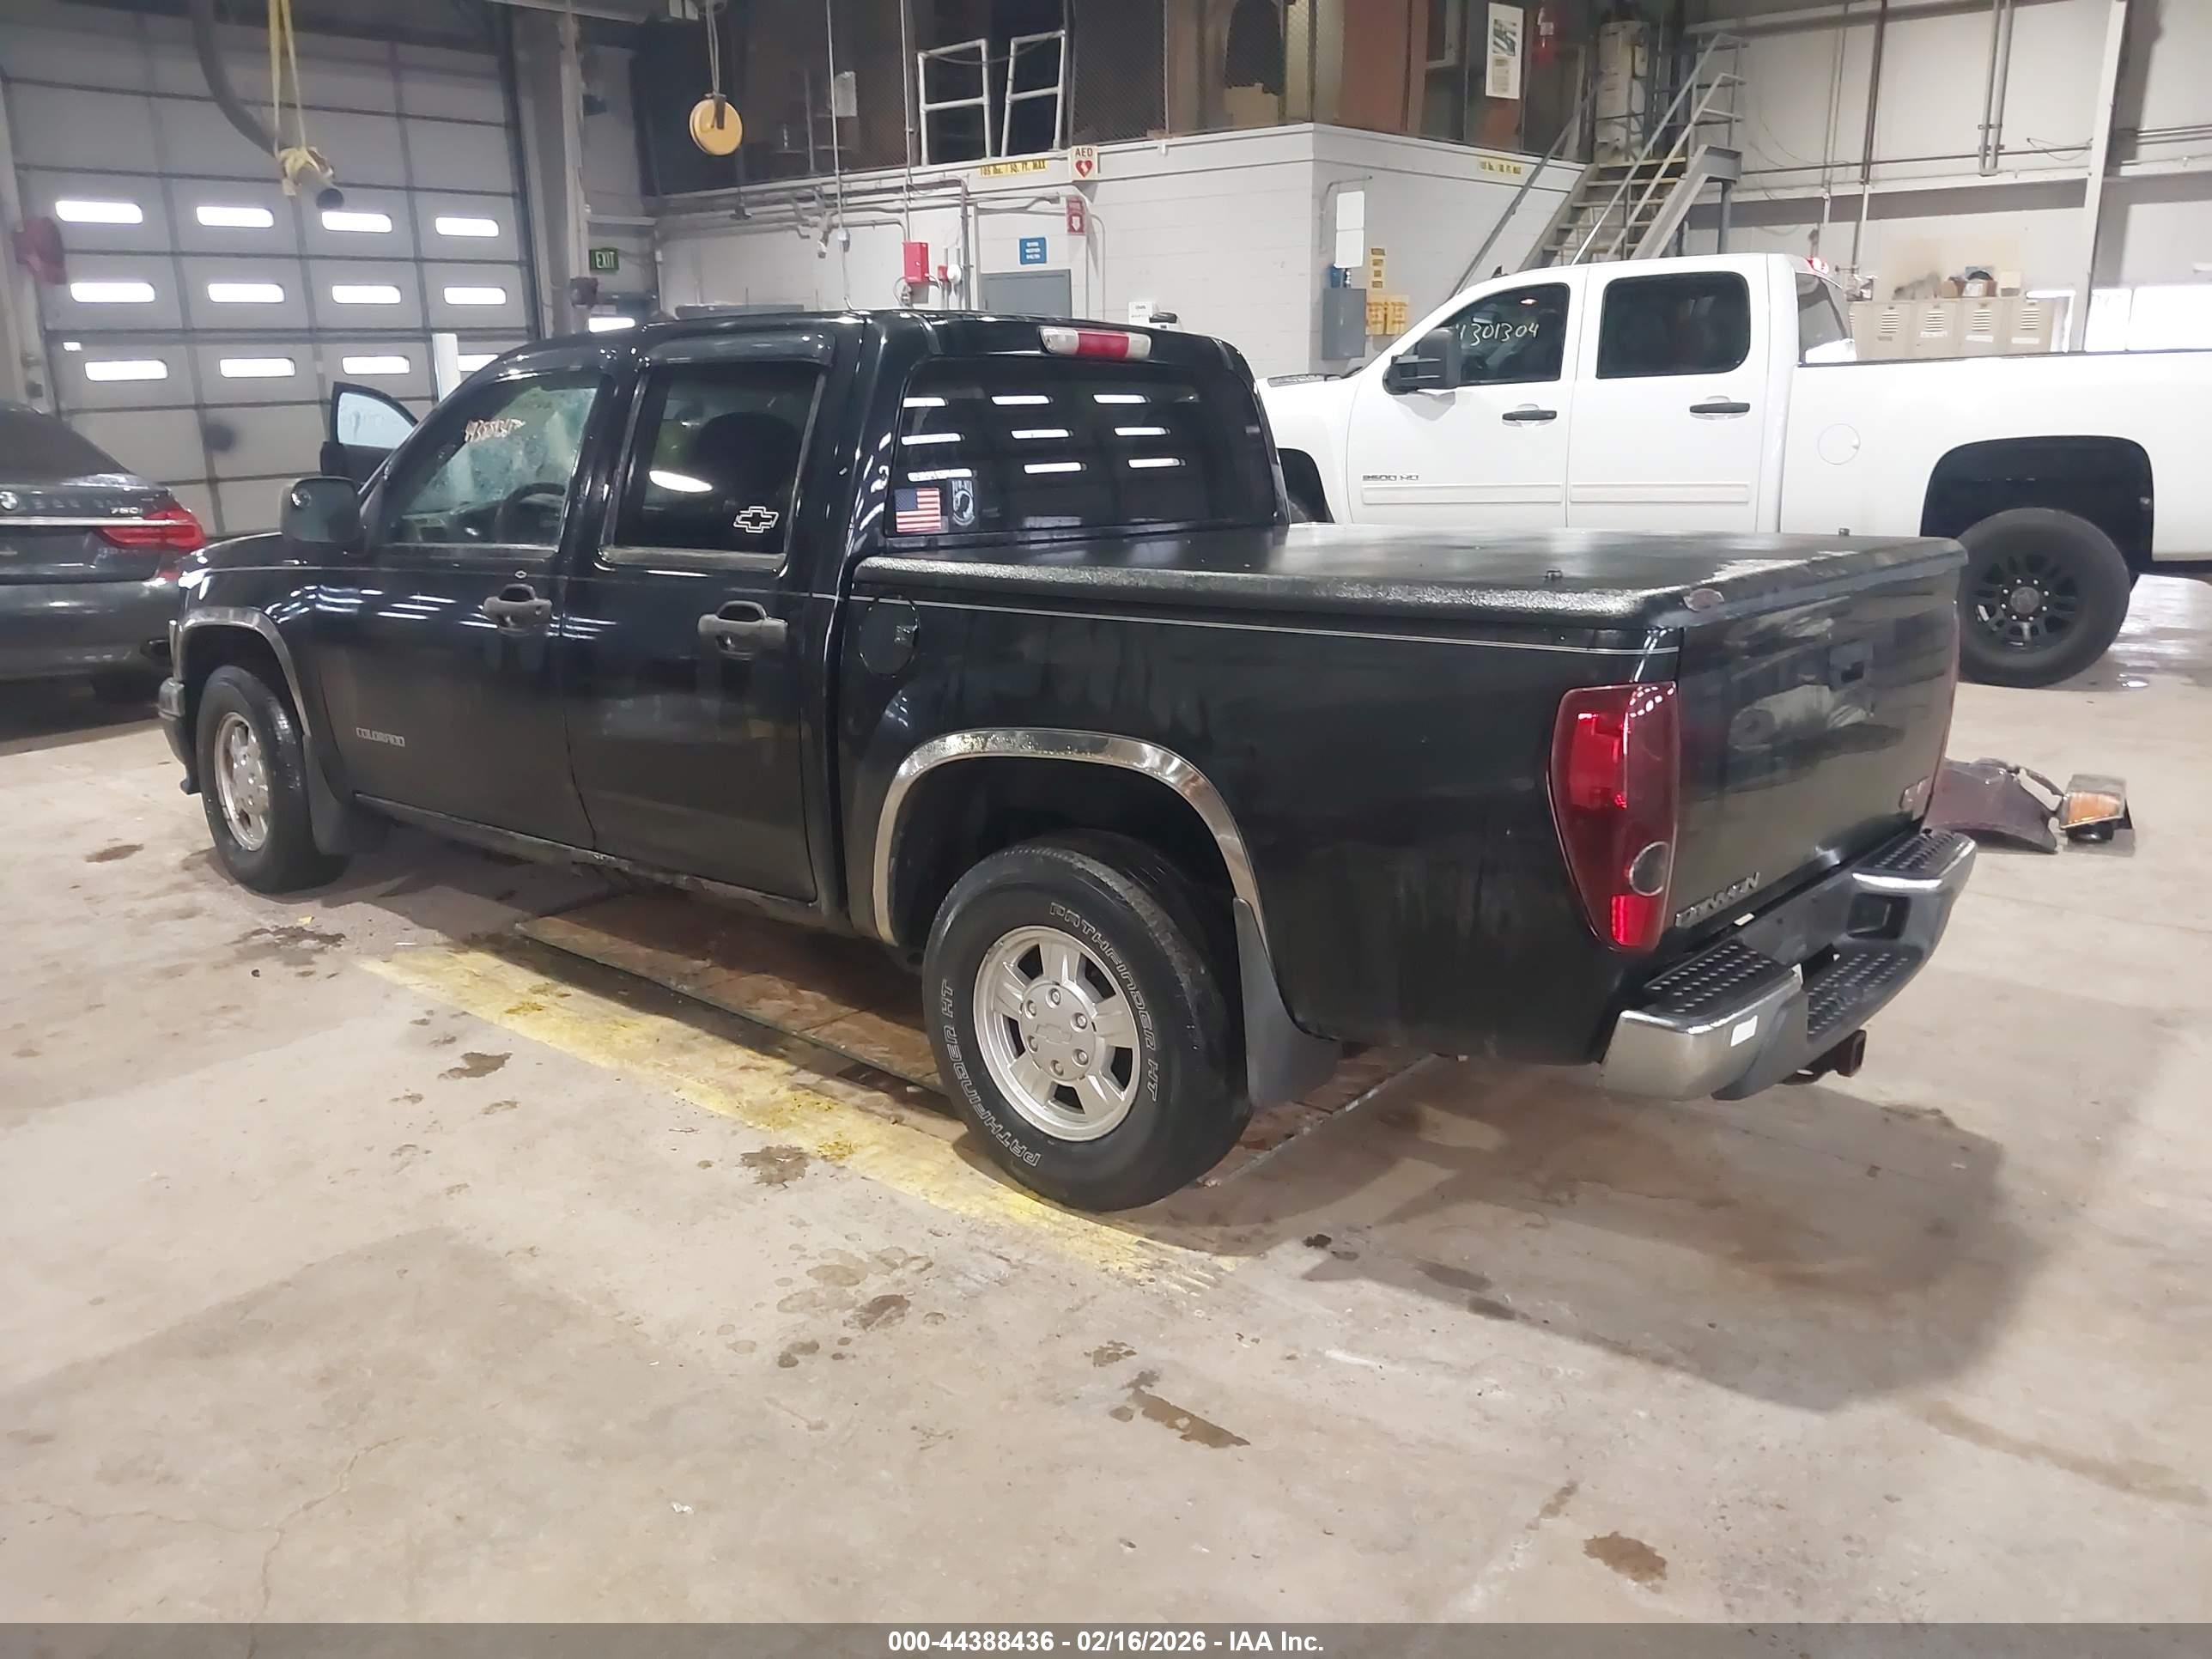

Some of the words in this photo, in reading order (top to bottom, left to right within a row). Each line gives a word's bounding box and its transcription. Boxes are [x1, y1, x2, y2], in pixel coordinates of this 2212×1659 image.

[1075, 148, 1093, 157] AED
[595, 251, 615, 269] EXIT
[356, 727, 406, 748] COLORADO
[941, 979, 955, 1018] HT
[1049, 902, 1156, 1051] PATHFINDER
[1146, 1057, 1161, 1103] HT
[943, 1024, 1042, 1167] PATHFINDER
